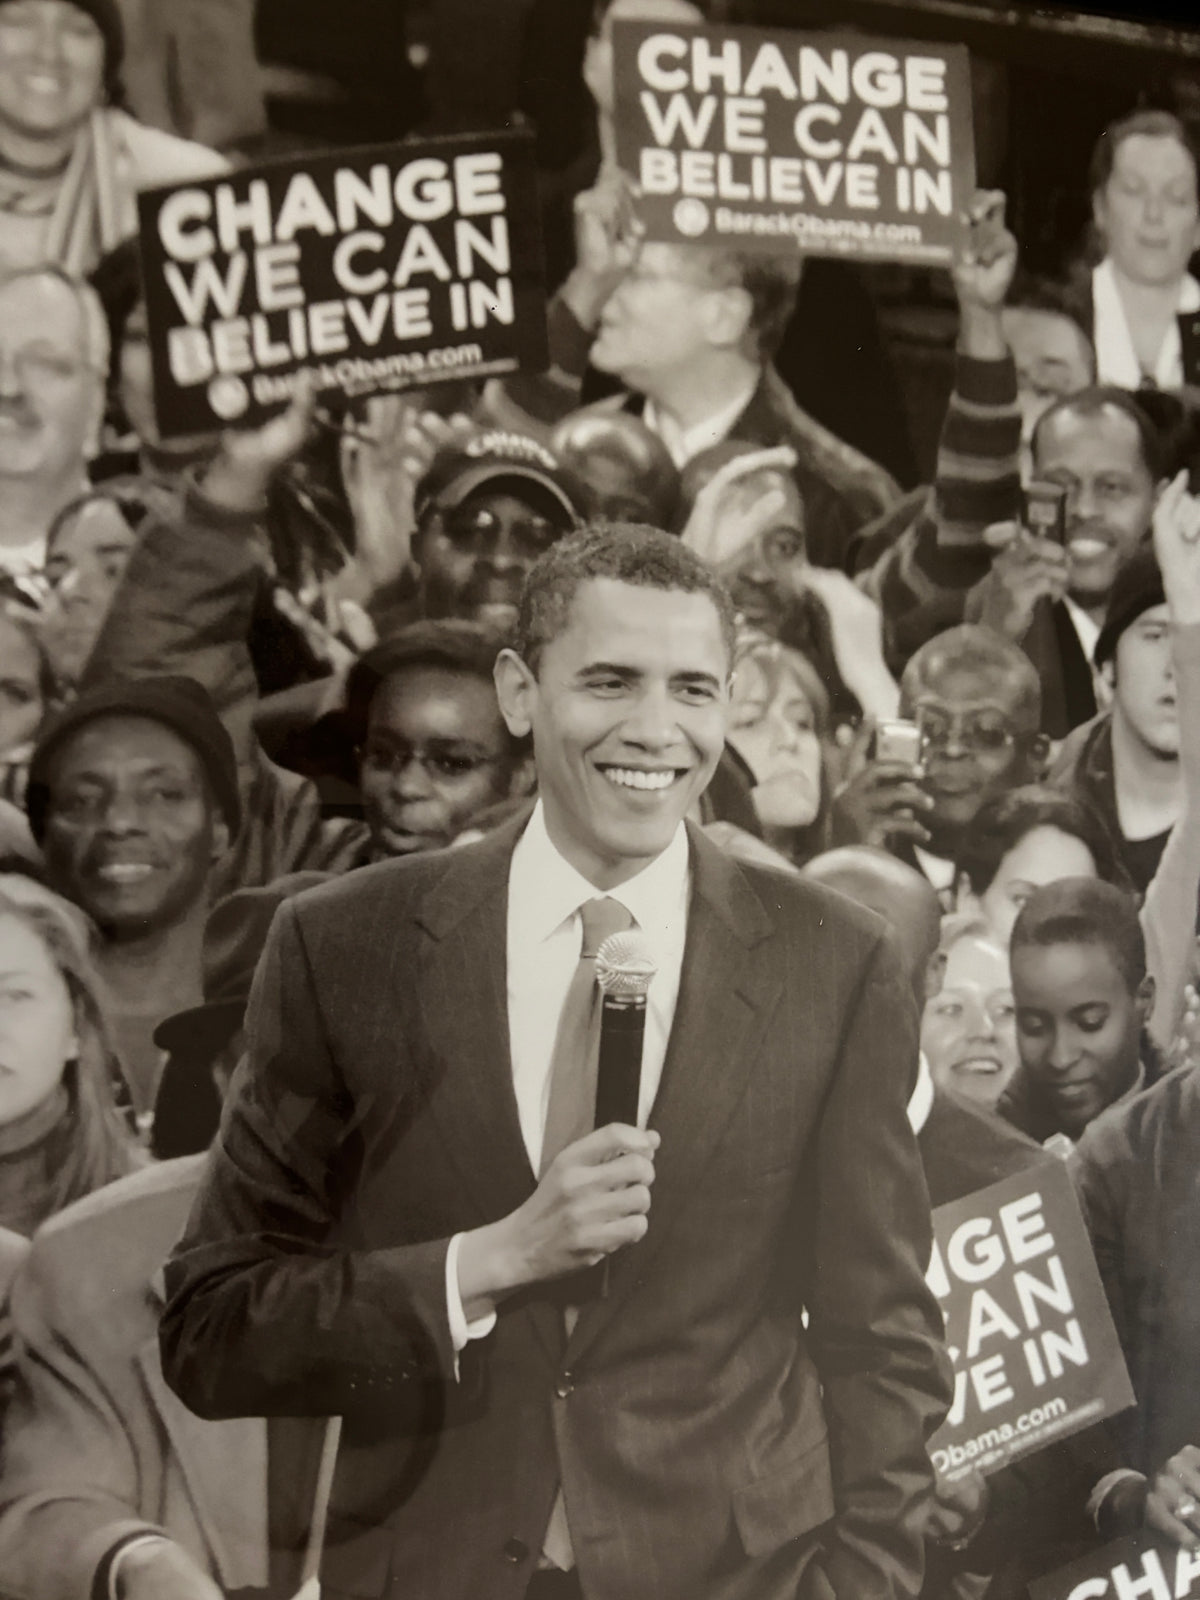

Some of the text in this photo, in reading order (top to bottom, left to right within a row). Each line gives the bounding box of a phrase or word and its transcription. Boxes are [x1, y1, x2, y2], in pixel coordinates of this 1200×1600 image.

[637, 33, 949, 112] CHANGE
[640, 90, 950, 168] WE CAN
[158, 152, 506, 264] CHANGE
[640, 147, 953, 217] BELIEVE IN
[715, 206, 922, 244] BarackObama.com
[163, 215, 511, 327] WE CAN
[167, 288, 433, 387] BELIEVE
[449, 276, 515, 331] IN
[252, 344, 483, 405] BarkObama.com
[943, 1254, 1074, 1363] AN
[1023, 1318, 1090, 1388] IN
[929, 1397, 1068, 1473] Obama.com
